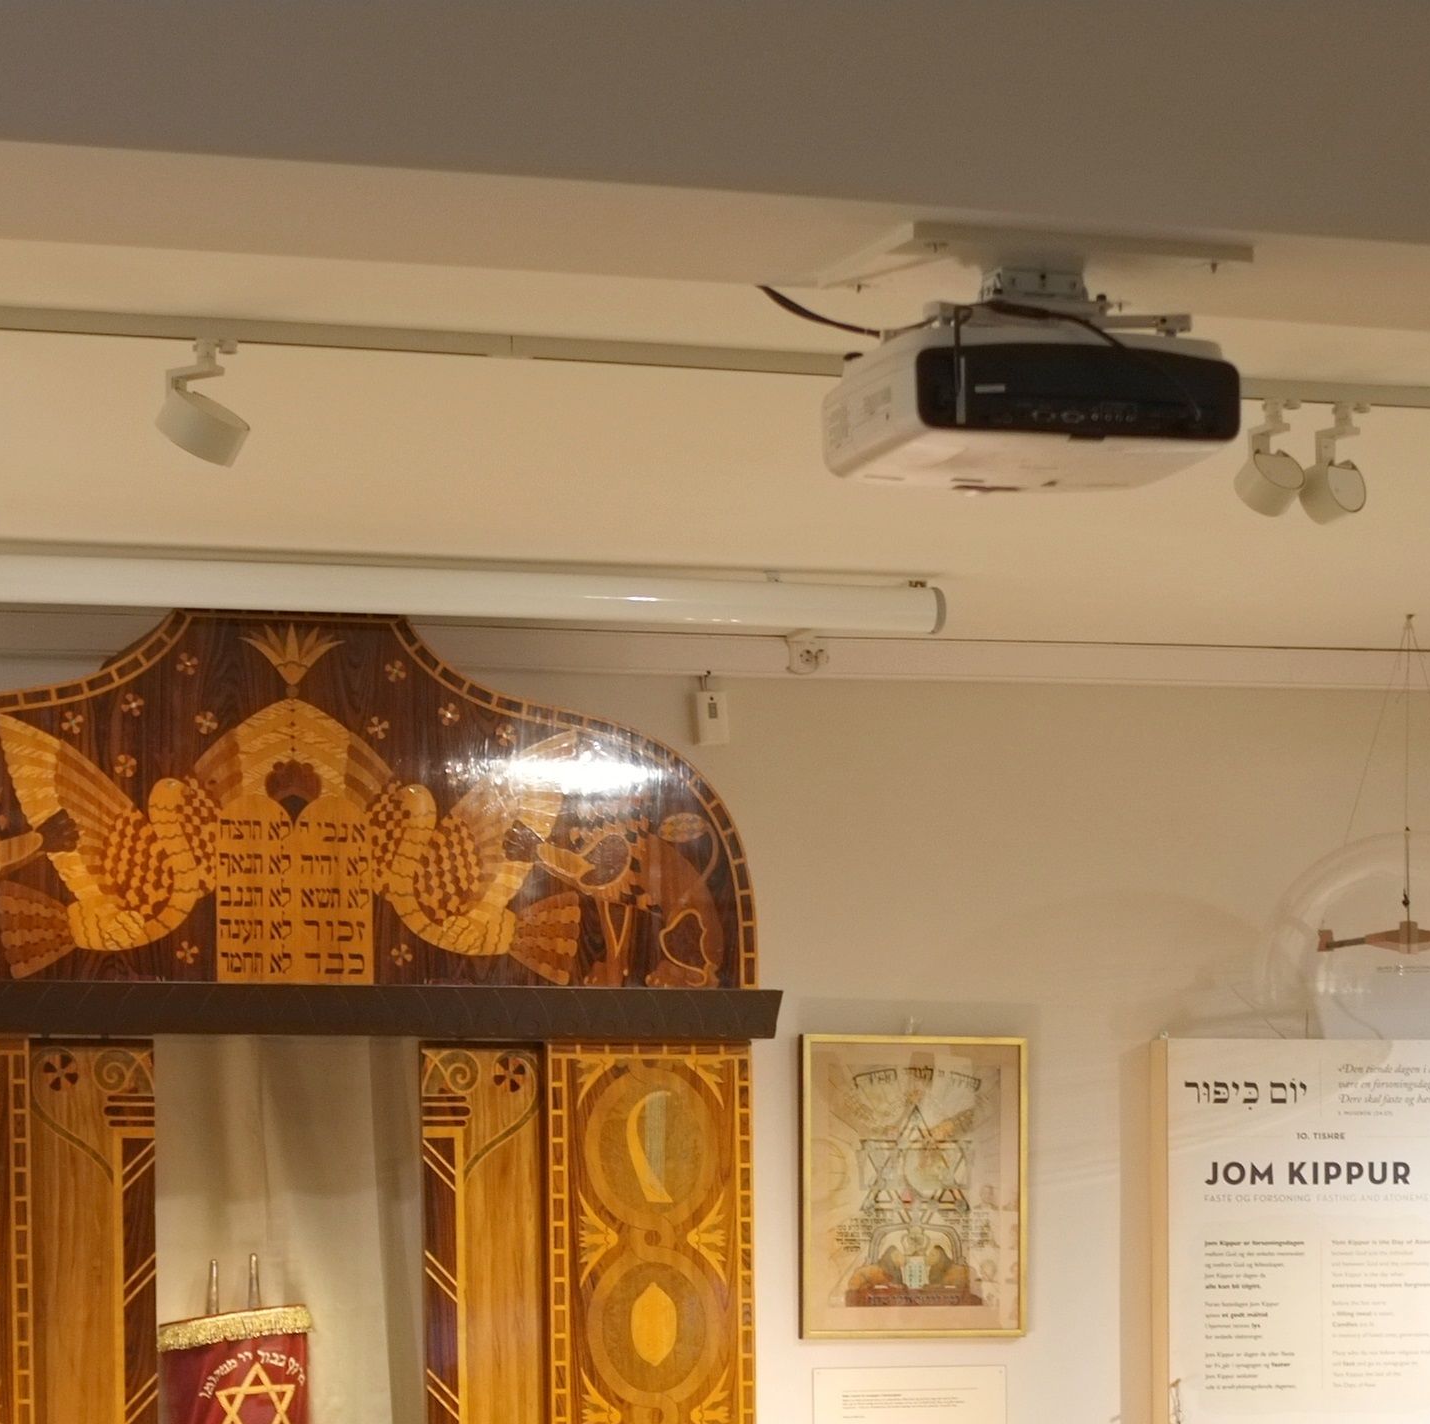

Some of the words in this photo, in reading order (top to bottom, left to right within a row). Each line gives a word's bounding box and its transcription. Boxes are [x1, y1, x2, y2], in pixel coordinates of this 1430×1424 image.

[220, 819, 261, 840] תרצח
[269, 812, 291, 841] לא
[219, 853, 262, 877] תנאף
[269, 845, 291, 874] לא
[301, 855, 338, 875] יהיה
[347, 846, 368, 876] לא
[269, 878, 291, 907] לא
[301, 888, 340, 908] תשא
[347, 879, 369, 909] לא
[270, 911, 292, 940] לא
[304, 920, 365, 941] זכור
[270, 944, 292, 974] לא
[305, 953, 365, 974] כבד
[1313, 1132, 1346, 1140] TISHRE
[1205, 1161, 1274, 1185] JOM
[1288, 1161, 1410, 1185] KIPPUR
[1204, 1194, 1232, 1202] FASTE
